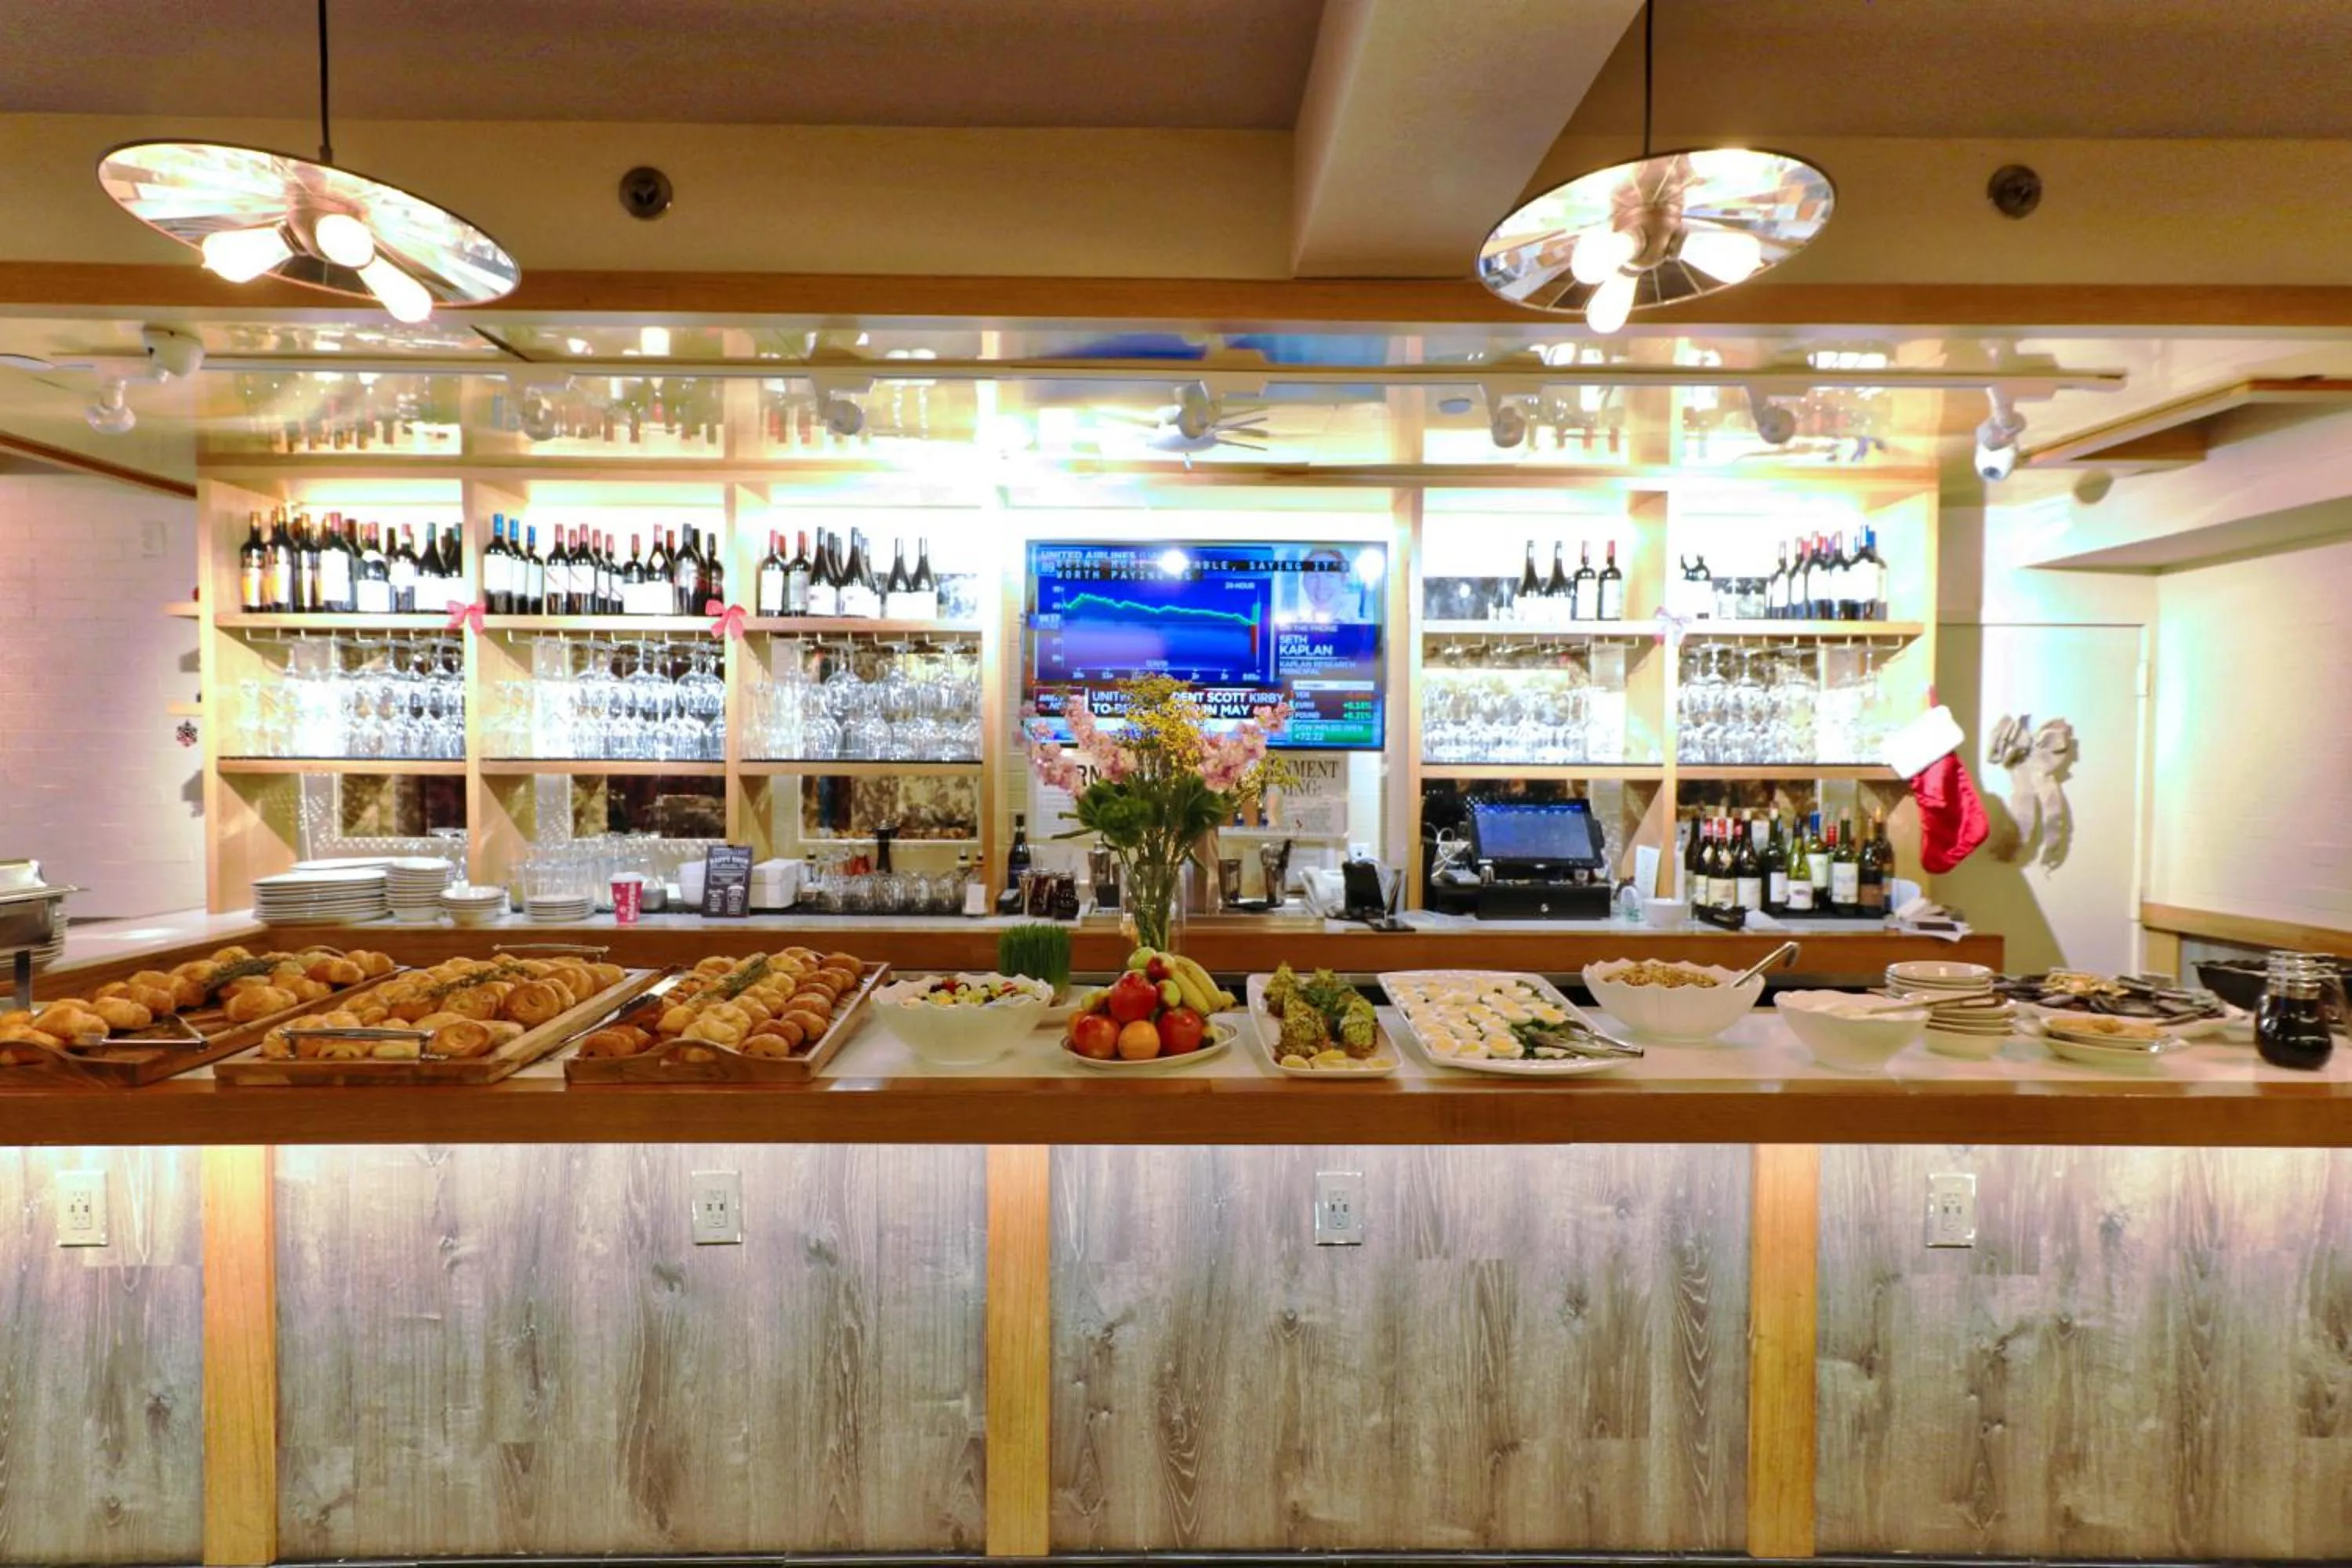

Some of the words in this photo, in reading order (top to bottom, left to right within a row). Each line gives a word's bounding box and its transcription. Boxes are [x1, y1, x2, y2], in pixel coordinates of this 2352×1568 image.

[1040, 550, 1083, 559] UNITED
[1279, 634, 1308, 644] SETH
[1279, 644, 1334, 656] KAPLAN
[1207, 691, 1246, 704] SCOTT
[1249, 692, 1284, 704] KIRBY
[1091, 703, 1111, 715] TO
[1203, 704, 1216, 715] IN
[1220, 704, 1250, 716] MAY
